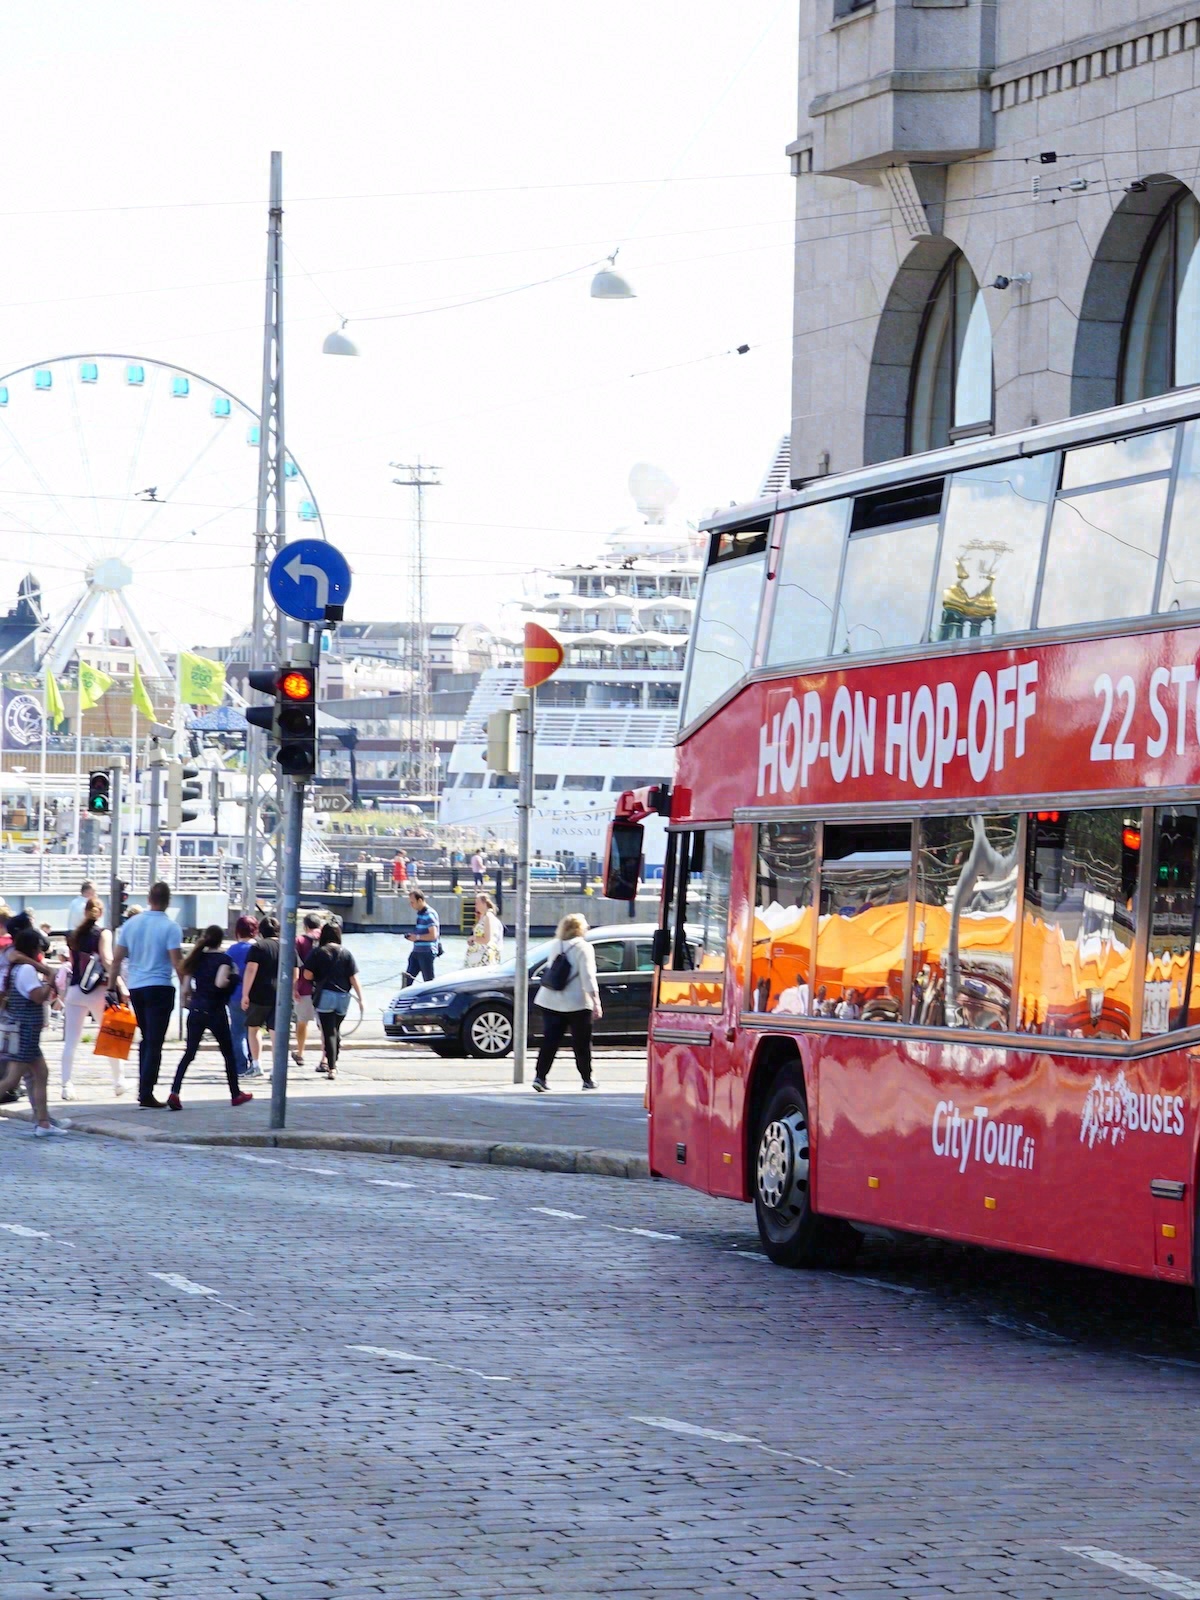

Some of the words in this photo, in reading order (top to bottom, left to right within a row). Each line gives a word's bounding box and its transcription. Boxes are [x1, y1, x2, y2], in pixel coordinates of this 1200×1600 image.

[757, 685, 876, 796] HOP-ON
[885, 660, 1039, 788] HOP-OFF
[1090, 674, 1135, 762] 22
[322, 798, 339, 808] WC
[552, 827, 600, 836] NASSAU
[932, 1100, 1034, 1173] CityTour.fi
[1127, 1092, 1184, 1136] BUSES
